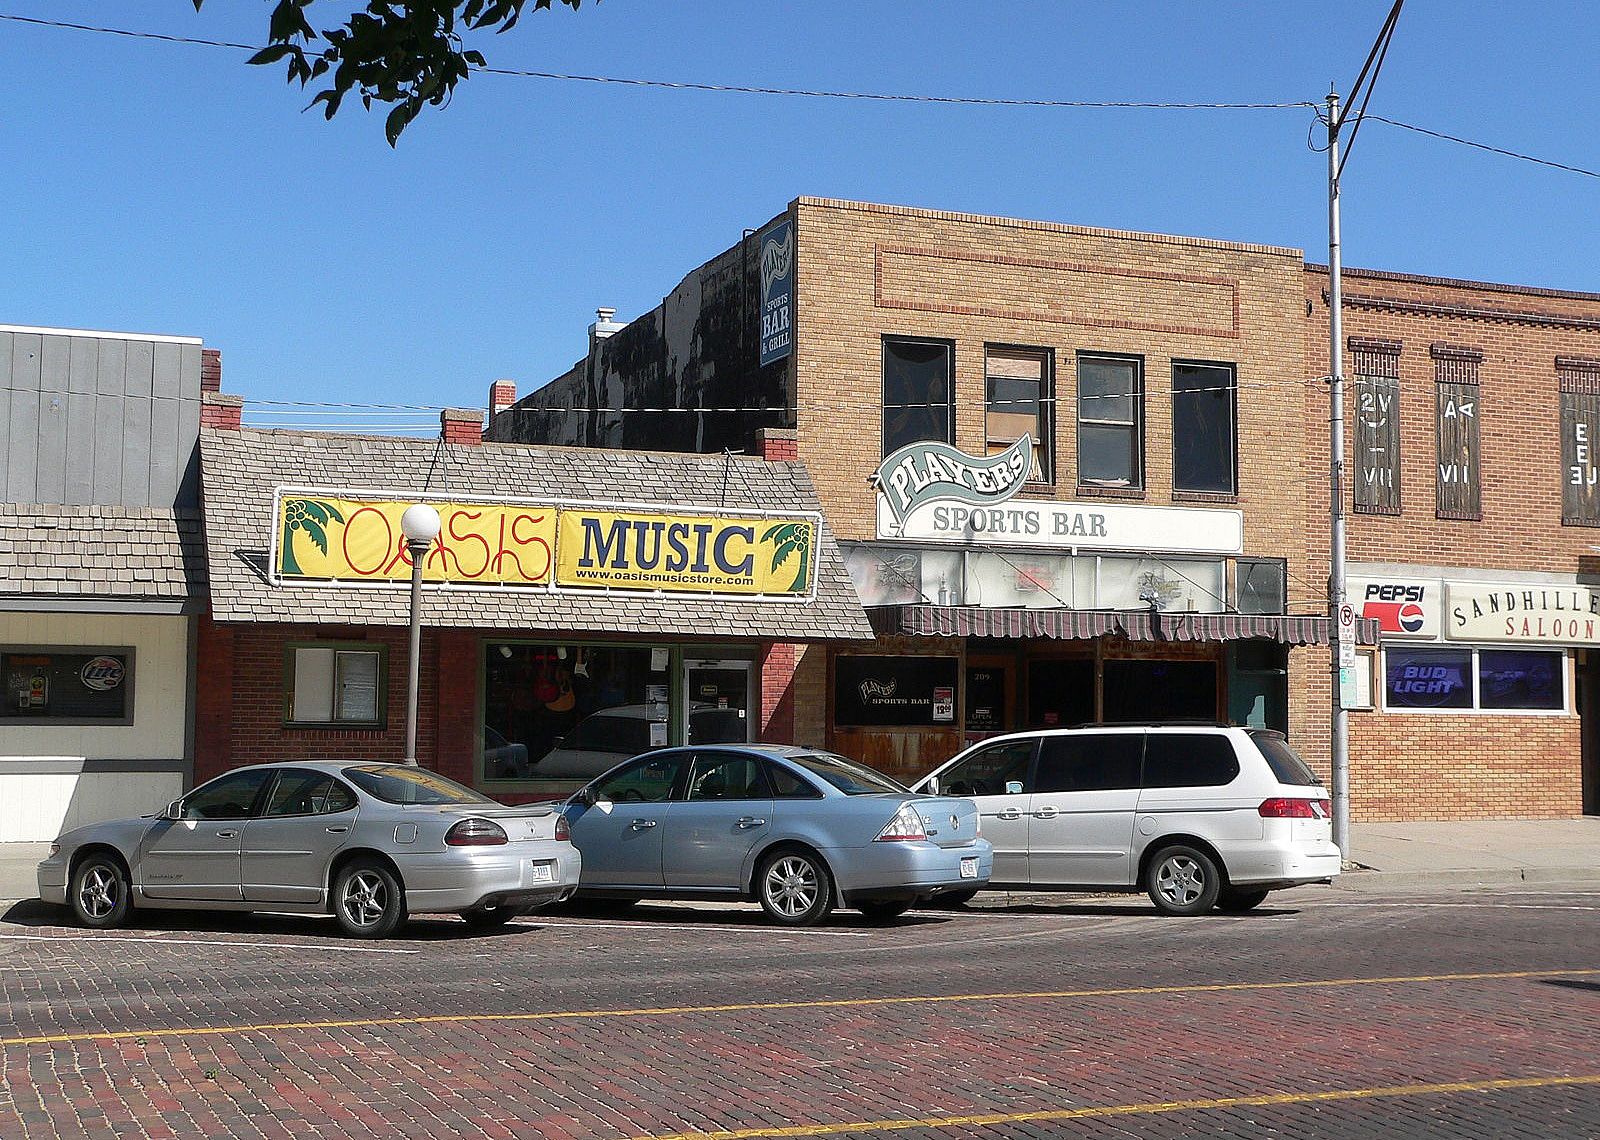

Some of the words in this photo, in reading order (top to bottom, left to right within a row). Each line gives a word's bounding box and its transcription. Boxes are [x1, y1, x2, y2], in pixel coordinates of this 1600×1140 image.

[767, 293, 788, 312] SPORTS
[762, 306, 790, 339] BAR
[768, 332, 790, 352] GRILL
[888, 447, 1025, 513] PLAYERS
[933, 506, 1041, 535] SPORTS
[1052, 511, 1108, 537] BAR
[578, 517, 755, 577] MUSIC
[575, 569, 754, 586] www.oasismusicstore.com
[1365, 584, 1425, 603] PEPSI
[1505, 617, 1594, 640] SALOON
[1403, 666, 1447, 679] BUD
[1393, 681, 1455, 694] LIGHT
